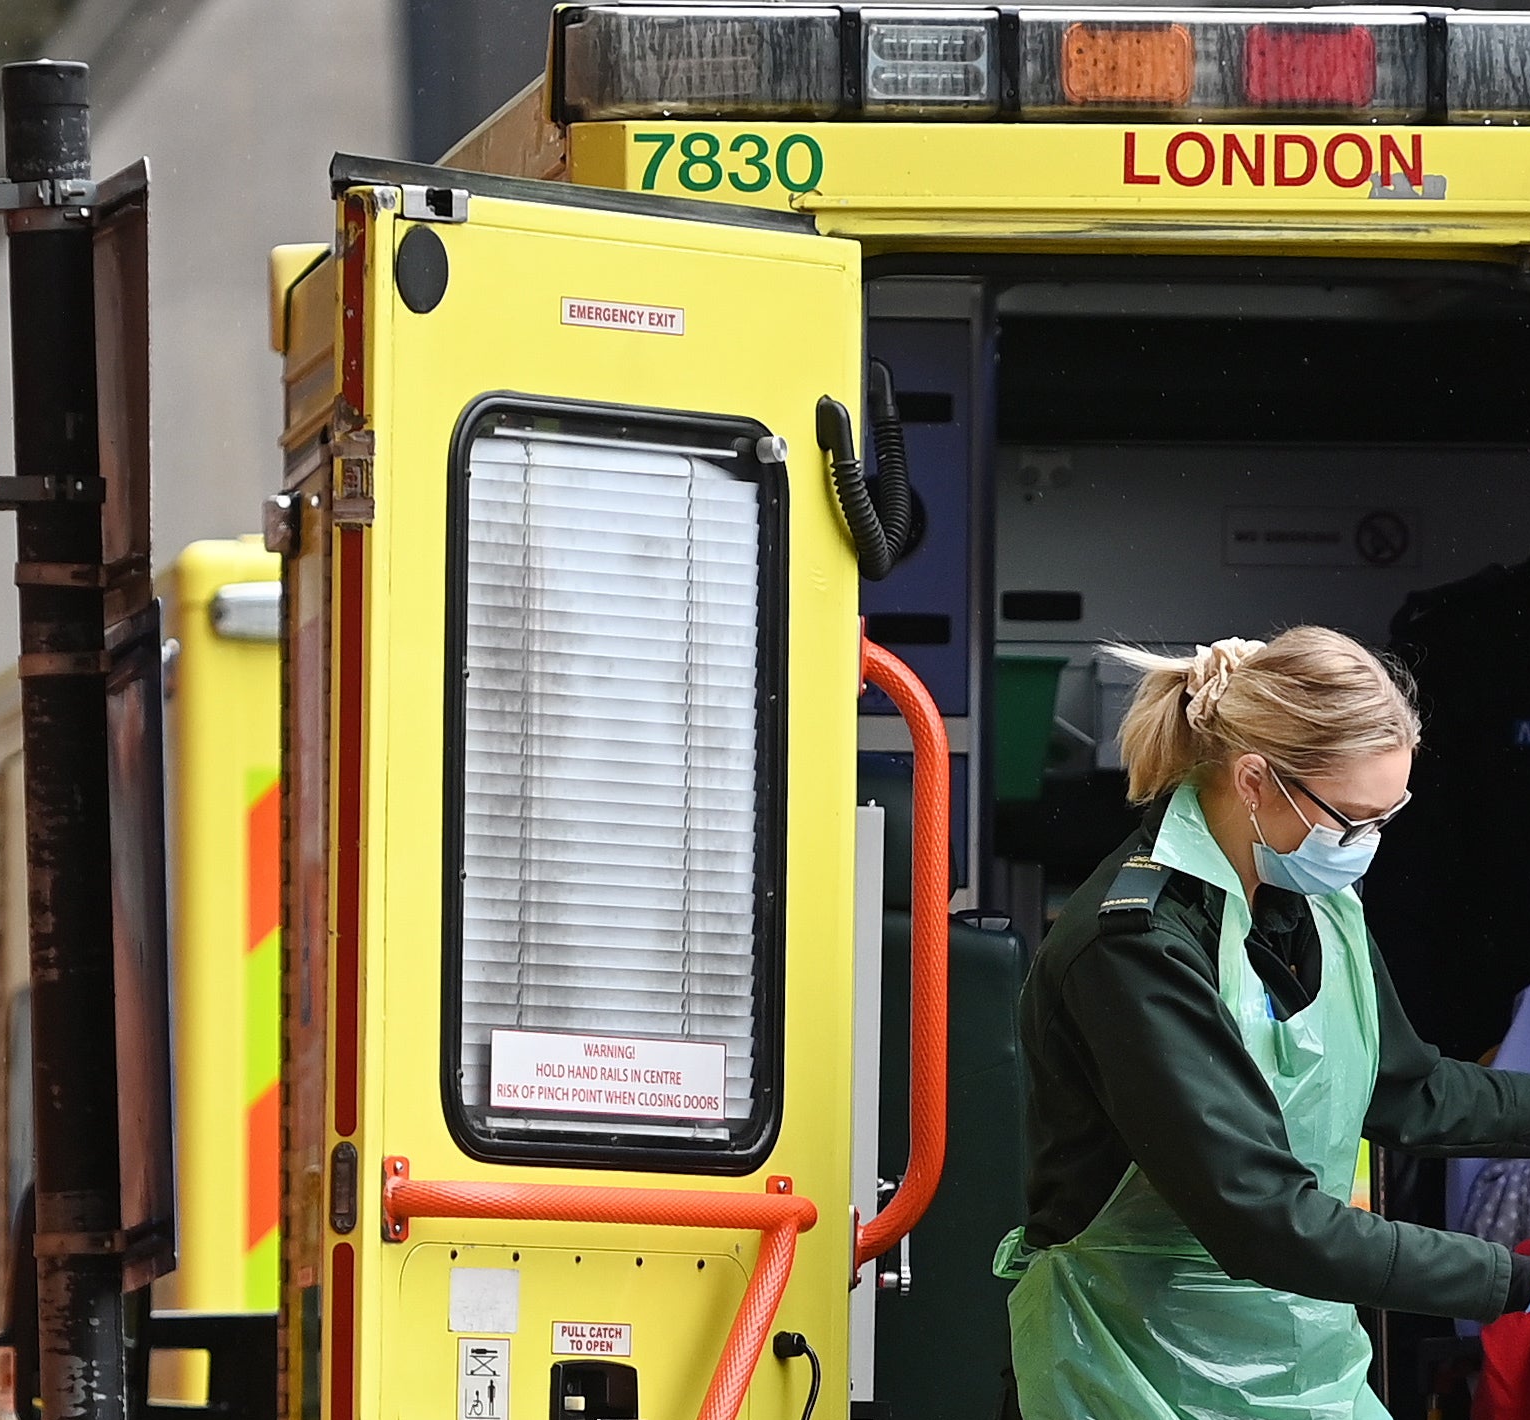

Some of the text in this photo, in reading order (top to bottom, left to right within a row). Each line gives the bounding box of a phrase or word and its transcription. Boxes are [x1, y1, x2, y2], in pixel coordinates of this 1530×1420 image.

[632, 132, 824, 194] 7830
[1122, 130, 1425, 189] LONDON
[568, 304, 677, 328] EMERGENCY EXIT
[583, 1042, 636, 1060] WARNING!
[536, 1063, 682, 1086] HOLD HAND RAILS IN CENTRE
[496, 1083, 720, 1111] RISK OF PINCH POINT WHEN CLOSING DOORS
[561, 1325, 623, 1339] PULL CATCH
[569, 1339, 613, 1352] TO OPEN
